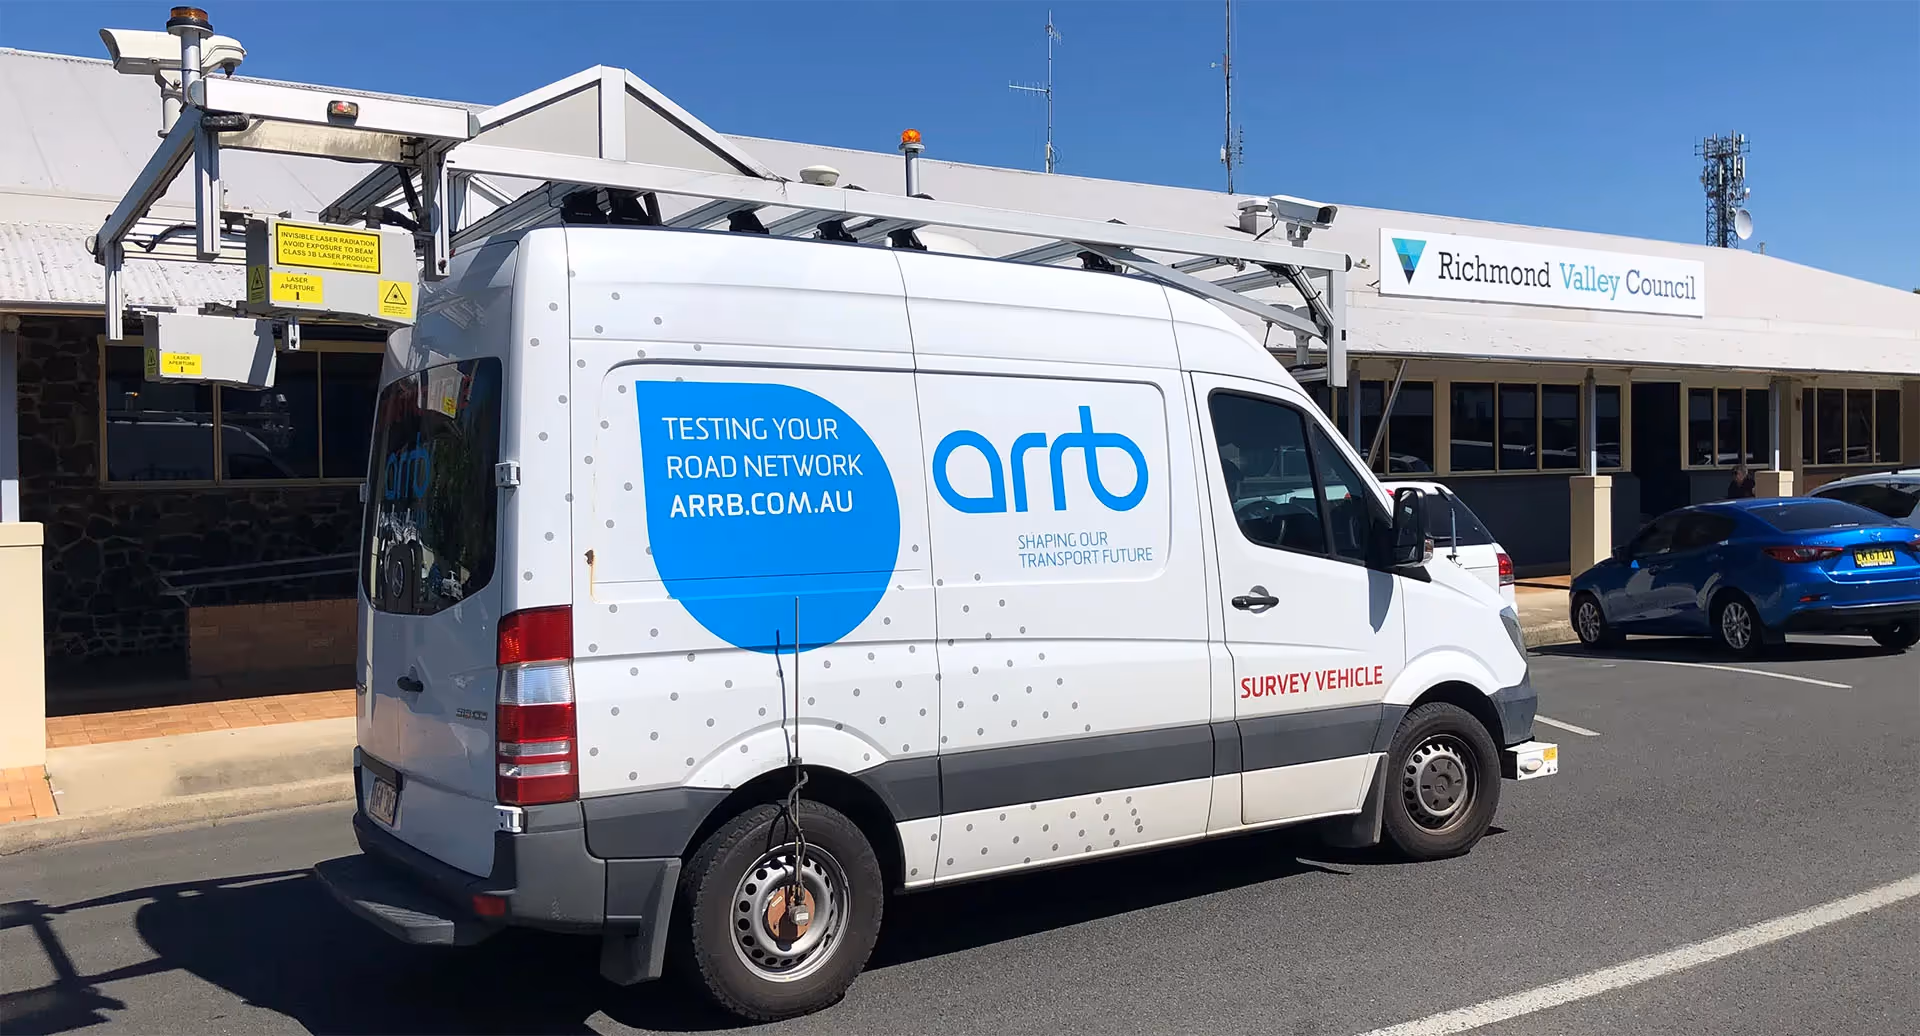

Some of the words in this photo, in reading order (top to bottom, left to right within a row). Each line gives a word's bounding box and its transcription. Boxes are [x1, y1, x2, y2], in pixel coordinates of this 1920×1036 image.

[281, 231, 314, 241] INVISIBLE
[315, 235, 338, 243] LASER
[339, 238, 375, 247] RADIATION
[283, 240, 305, 248] AVOID
[306, 243, 343, 252] EXPOSURE
[282, 248, 307, 256] CLASS
[318, 252, 341, 260] LASER
[342, 254, 374, 263] PRODUCT
[280, 283, 315, 291] APERTURE
[1438, 251, 1551, 288] Richmond
[1559, 262, 1620, 300] Valley
[1626, 268, 1696, 300] Council
[661, 417, 768, 440] TESTING
[772, 418, 839, 440] YOUR
[385, 431, 432, 500] arrb
[666, 455, 737, 479] ROAD
[744, 454, 864, 478] NETWORK
[932, 405, 1149, 514] arrb
[670, 490, 853, 518] ARRB.COM.AU
[1018, 532, 1077, 550] SHAPING
[1079, 531, 1108, 547] OUR
[1018, 549, 1099, 568] TRANSPORT
[1102, 547, 1153, 564] FUTURE
[1240, 672, 1311, 698] SURVEY
[1315, 665, 1383, 691] VEHICLE
